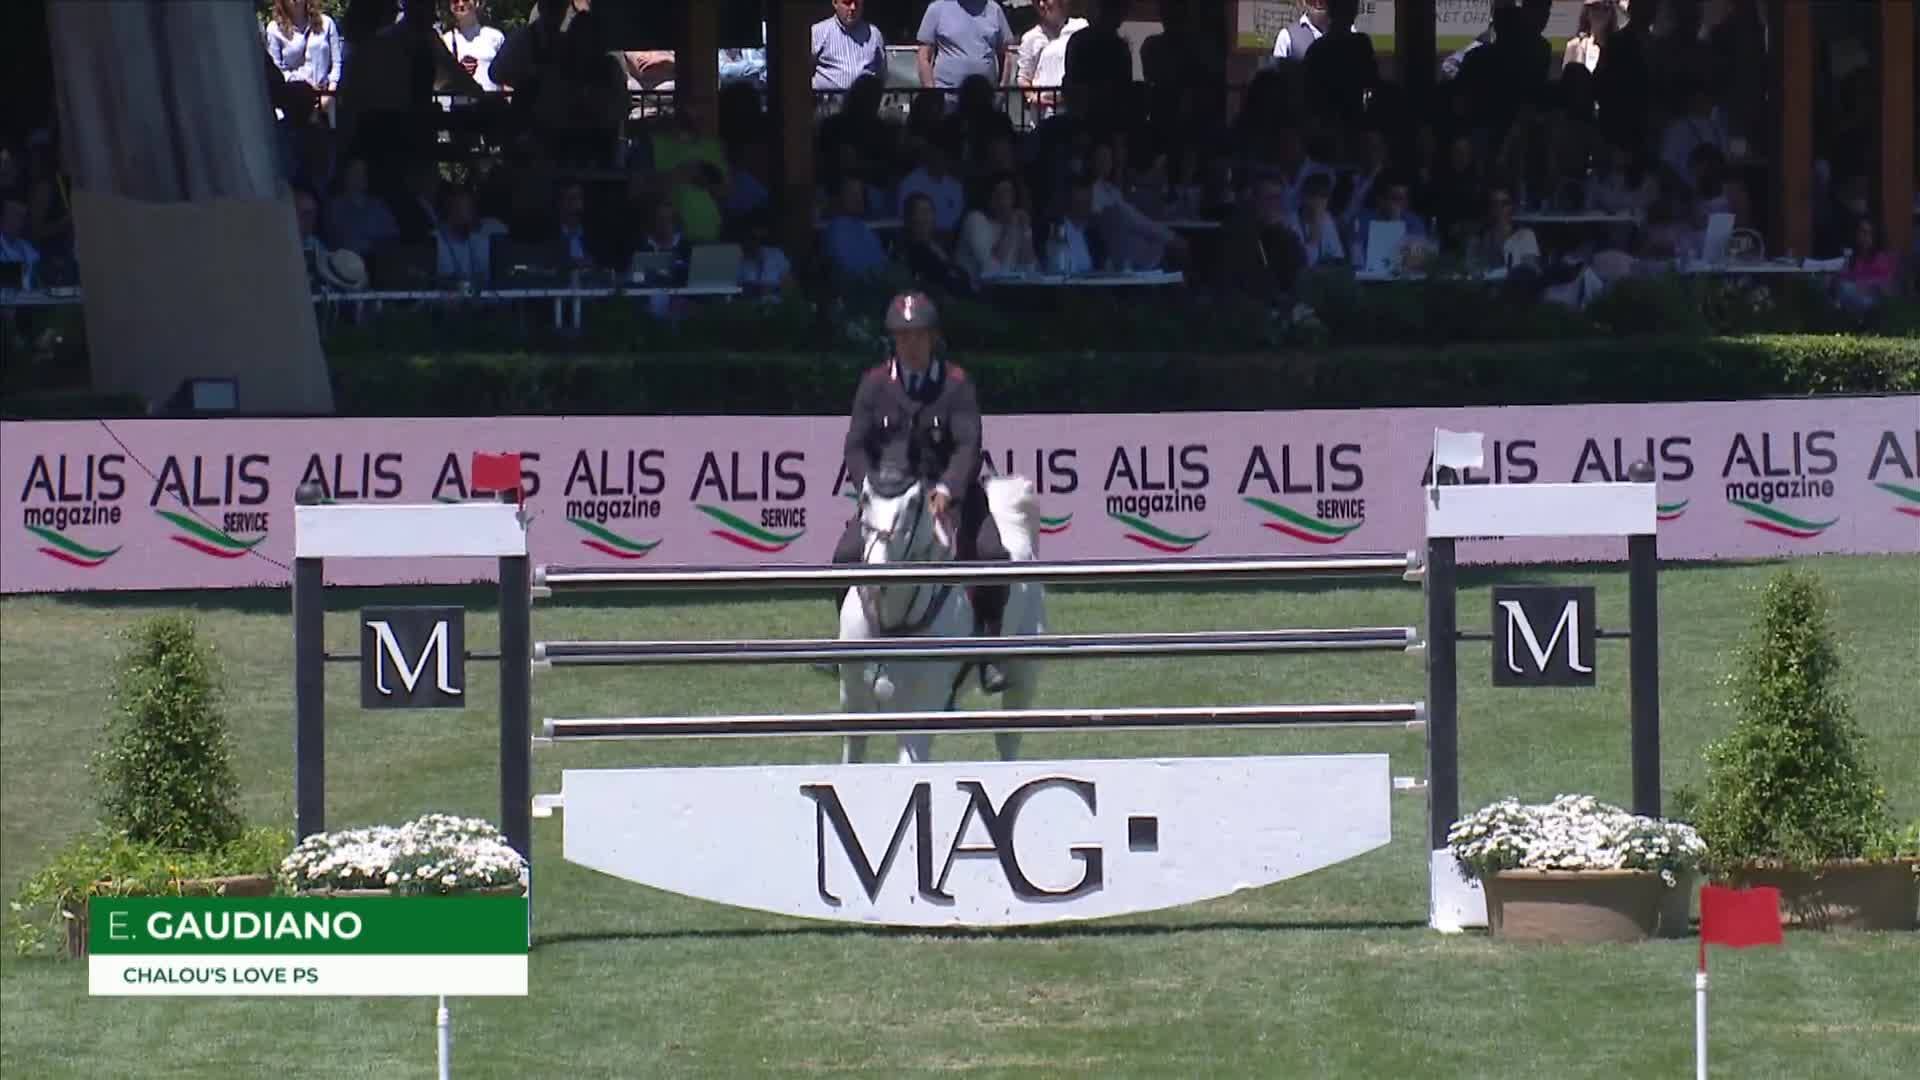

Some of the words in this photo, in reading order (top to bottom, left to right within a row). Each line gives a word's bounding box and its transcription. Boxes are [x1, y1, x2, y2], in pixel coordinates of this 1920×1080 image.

[299, 453, 402, 500] ALIS
[432, 452, 541, 499] AS
[564, 449, 665, 497] ALIS
[690, 451, 806, 502] ALIS
[1104, 445, 1210, 491] ALIS
[1238, 443, 1364, 495] ALIS
[1722, 430, 1838, 477] ALIS
[21, 454, 126, 502] ALIS
[150, 454, 270, 507] ALIS
[1725, 473, 1834, 504] magazine
[24, 500, 122, 531] magazine
[223, 511, 269, 532] SERVICE
[566, 497, 661, 525] magazine
[760, 507, 806, 529] SERVICE
[1106, 488, 1207, 519] magazine
[1317, 498, 1365, 520] SERVICE
[366, 621, 462, 694] M
[1499, 600, 1593, 673] M
[800, 777, 1104, 908] MAG
